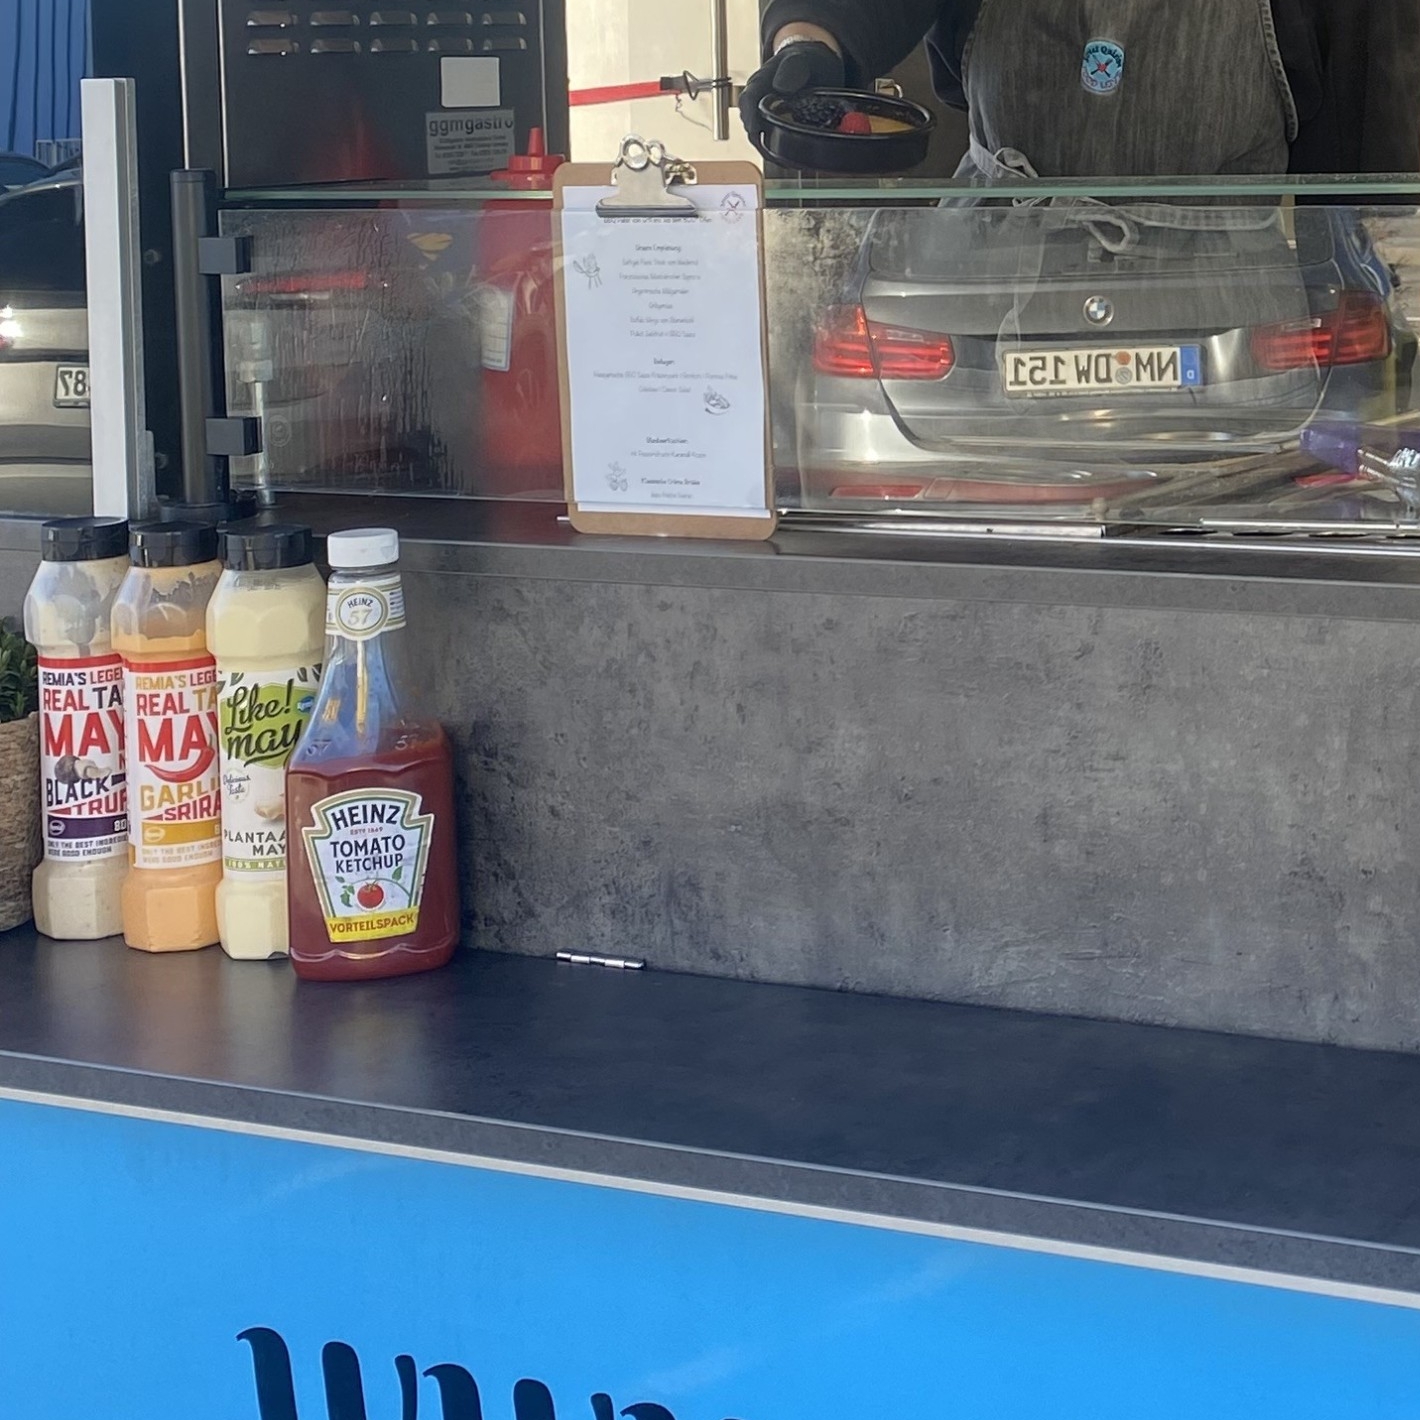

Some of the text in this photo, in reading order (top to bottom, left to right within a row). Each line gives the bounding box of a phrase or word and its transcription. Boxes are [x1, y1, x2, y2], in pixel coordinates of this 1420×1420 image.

[347, 598, 373, 609] HEINZ
[347, 609, 373, 626] 57
[42, 671, 87, 686] REMIA'S
[136, 675, 187, 690] REMIA'S
[43, 684, 123, 711] REAL TA
[136, 692, 190, 716] REAL
[225, 678, 294, 735] Like!
[46, 775, 110, 807] BLACK
[141, 777, 218, 811] GARLI
[331, 804, 400, 830] HEINZ
[330, 834, 405, 858] TOMATO
[336, 854, 403, 874] KETCHUP
[330, 913, 414, 933] VORTEILSPACK
